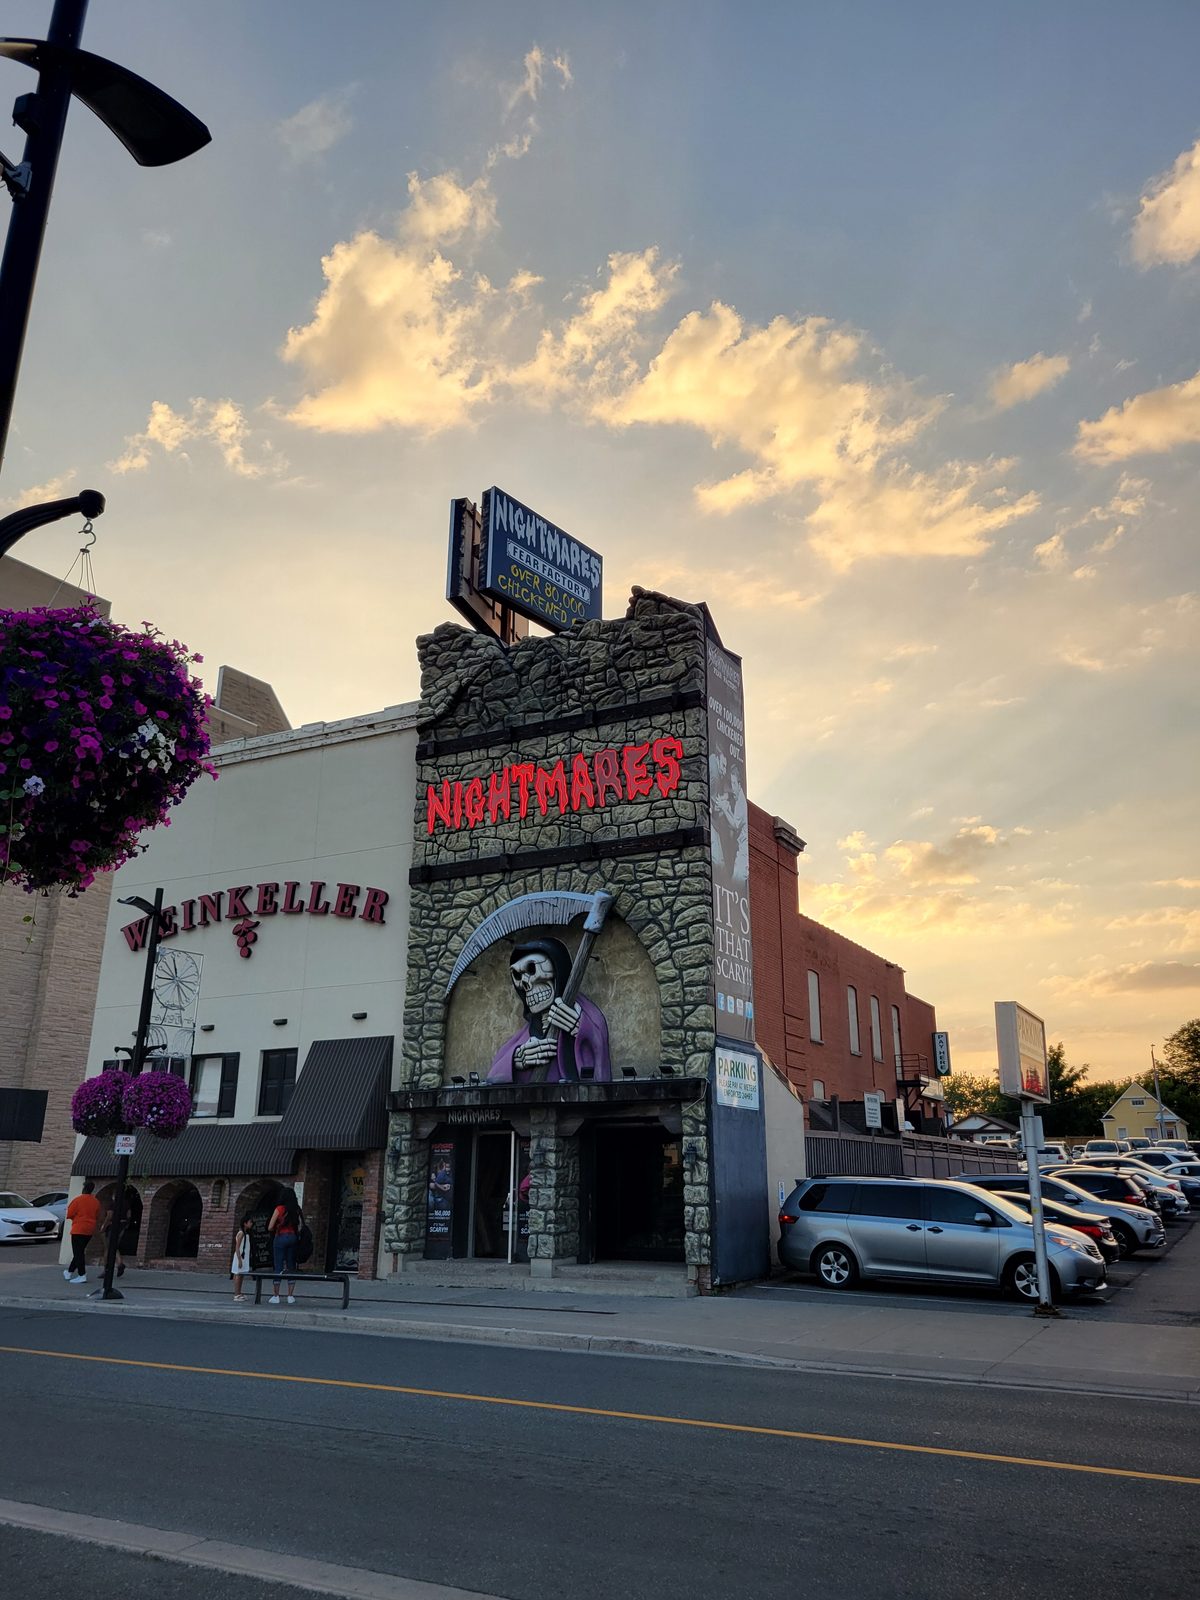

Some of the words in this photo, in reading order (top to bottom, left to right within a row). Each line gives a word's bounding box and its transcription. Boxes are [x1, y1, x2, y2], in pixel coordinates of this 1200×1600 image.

[496, 493, 601, 588] NIGHTMARES
[511, 564, 541, 594] OVER
[544, 582, 585, 617] 80,000
[513, 544, 540, 570] FEAR
[542, 562, 586, 598] FACTORY
[497, 574, 567, 623] CHICKENED
[708, 695, 722, 716] OVER
[716, 718, 743, 747] CHICKENED
[426, 736, 683, 836] NIGHTMARES
[120, 880, 389, 952] WEINKELLER
[714, 883, 750, 935] IT'S
[715, 925, 751, 963] THAT
[716, 955, 752, 987] SCARY!!
[719, 1057, 757, 1082] PARKING
[448, 1109, 501, 1124] NIGHTMARES
